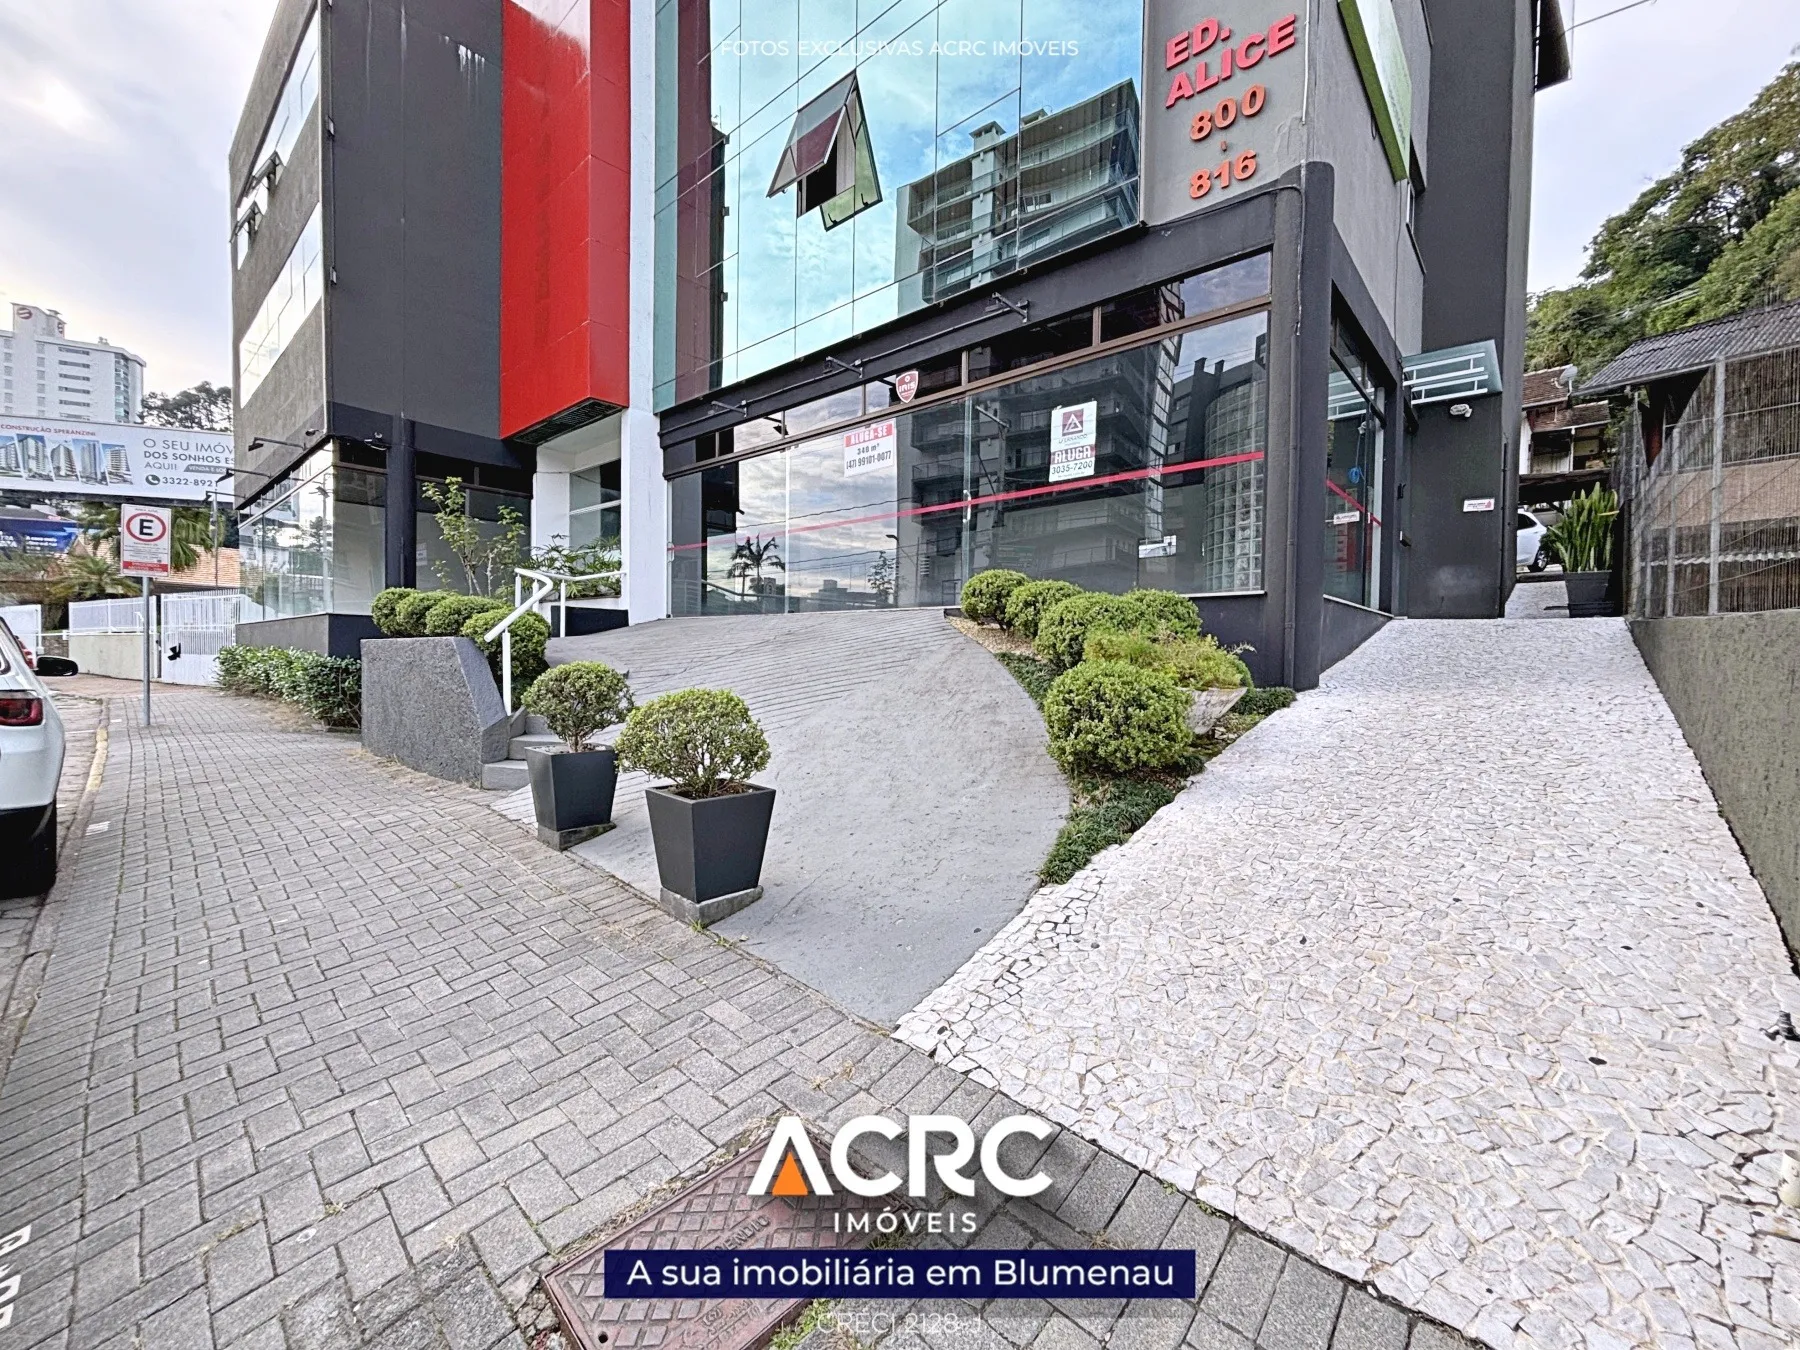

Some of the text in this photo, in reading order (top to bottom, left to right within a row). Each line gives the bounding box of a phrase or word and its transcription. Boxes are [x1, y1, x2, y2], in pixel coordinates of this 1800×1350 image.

[1165, 16, 1232, 71] ED.
[1164, 13, 1297, 110] ALICE
[1188, 84, 1267, 143] 800
[1188, 149, 1258, 200] 816
[0, 424, 52, 434] CONSTRUÇÃO
[850, 424, 888, 446] ALUGA-SE
[143, 438, 234, 455] O SEU IMÓV
[1054, 445, 1091, 464] ALUGA
[143, 450, 168, 460] DOS
[172, 452, 221, 464] SONHOS
[144, 461, 178, 471] AQUI!
[1051, 460, 1093, 475] 3035-7200
[139, 518, 154, 536] E
